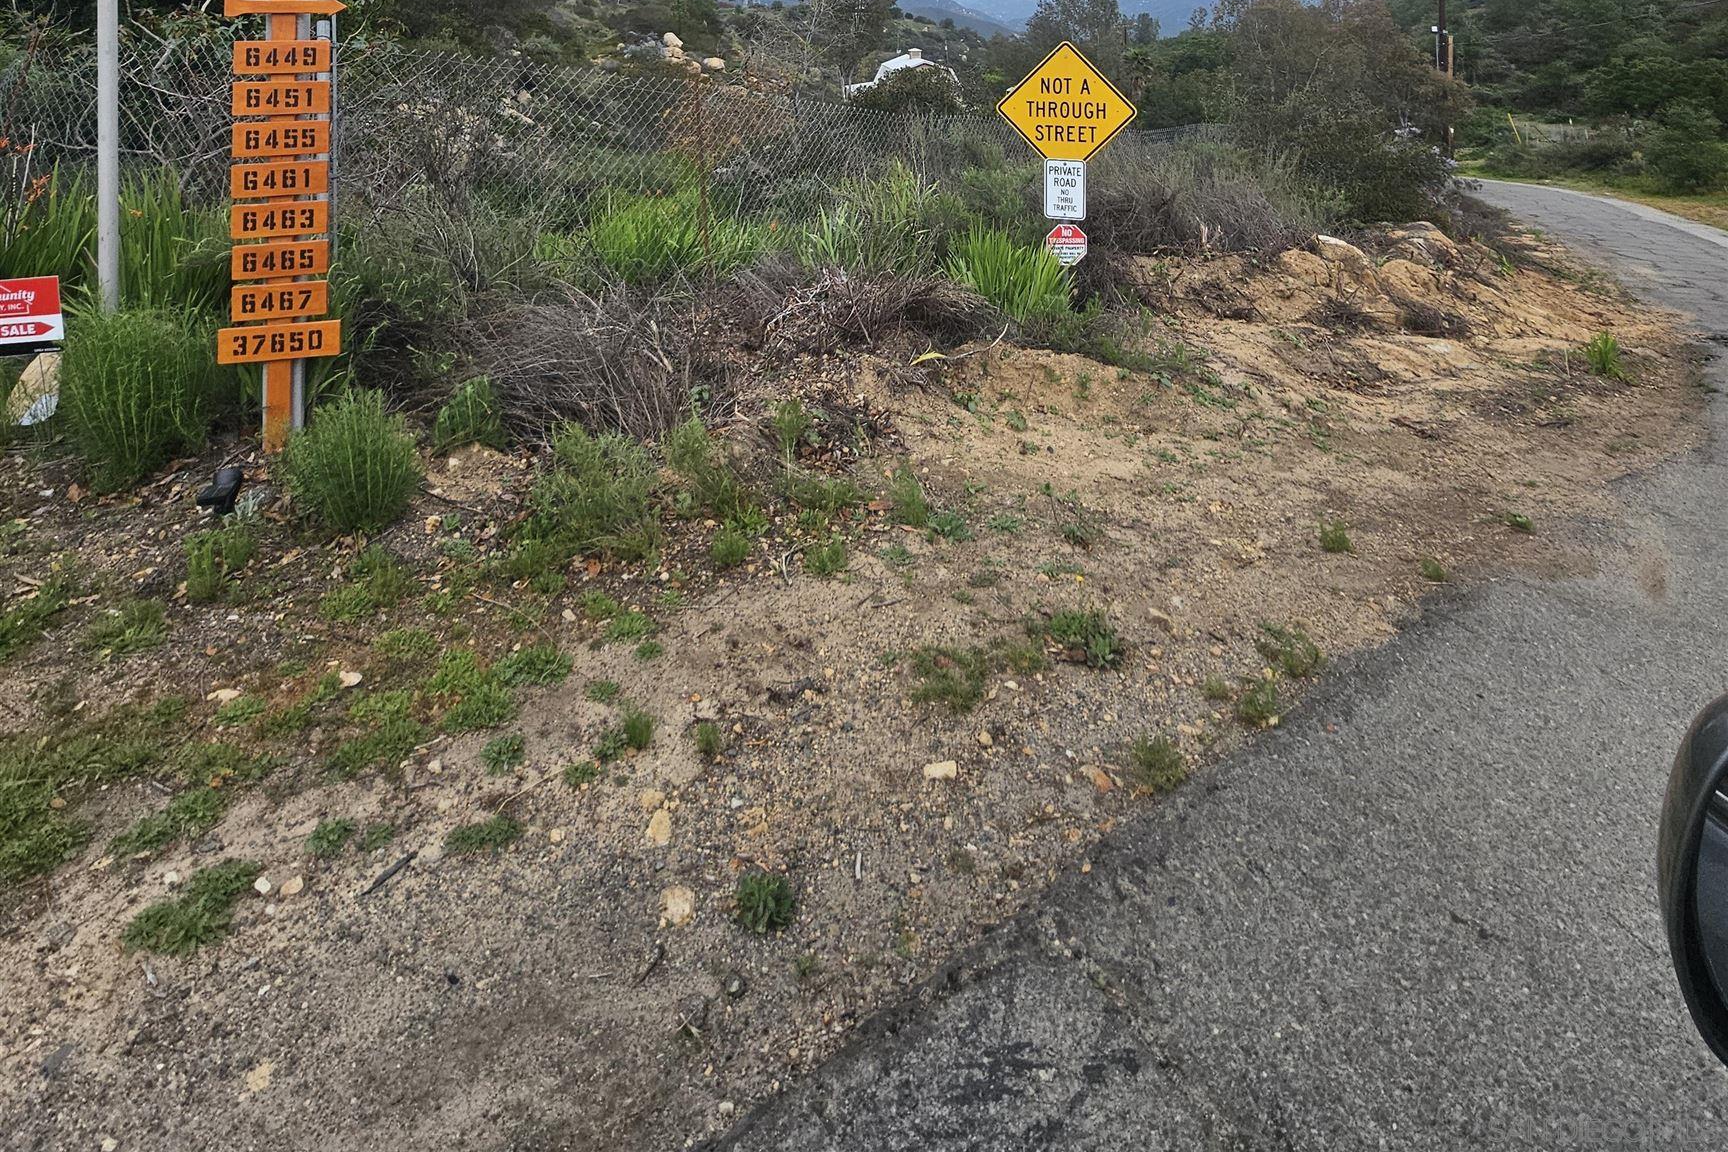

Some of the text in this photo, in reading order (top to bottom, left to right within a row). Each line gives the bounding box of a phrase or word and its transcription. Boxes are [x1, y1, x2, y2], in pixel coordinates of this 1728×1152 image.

[246, 46, 317, 67] 6449
[1041, 78, 1090, 95] NOT A
[246, 87, 313, 108] 6451
[1026, 101, 1106, 119] THROUGH
[245, 128, 316, 150] 6455
[1035, 125, 1097, 143] STREET
[243, 168, 311, 190] 6461
[1048, 166, 1081, 176] PRIVATE
[1054, 178, 1076, 188] ROAD
[1053, 204, 1077, 212] TRAFFIC
[1057, 196, 1073, 204] THRU
[243, 208, 314, 231] 6463
[1062, 228, 1072, 236] NO
[243, 249, 314, 272] 6465
[0, 290, 35, 301] unity
[242, 290, 313, 312] 6467
[1, 324, 36, 336] SALE
[232, 329, 323, 356] 37650
